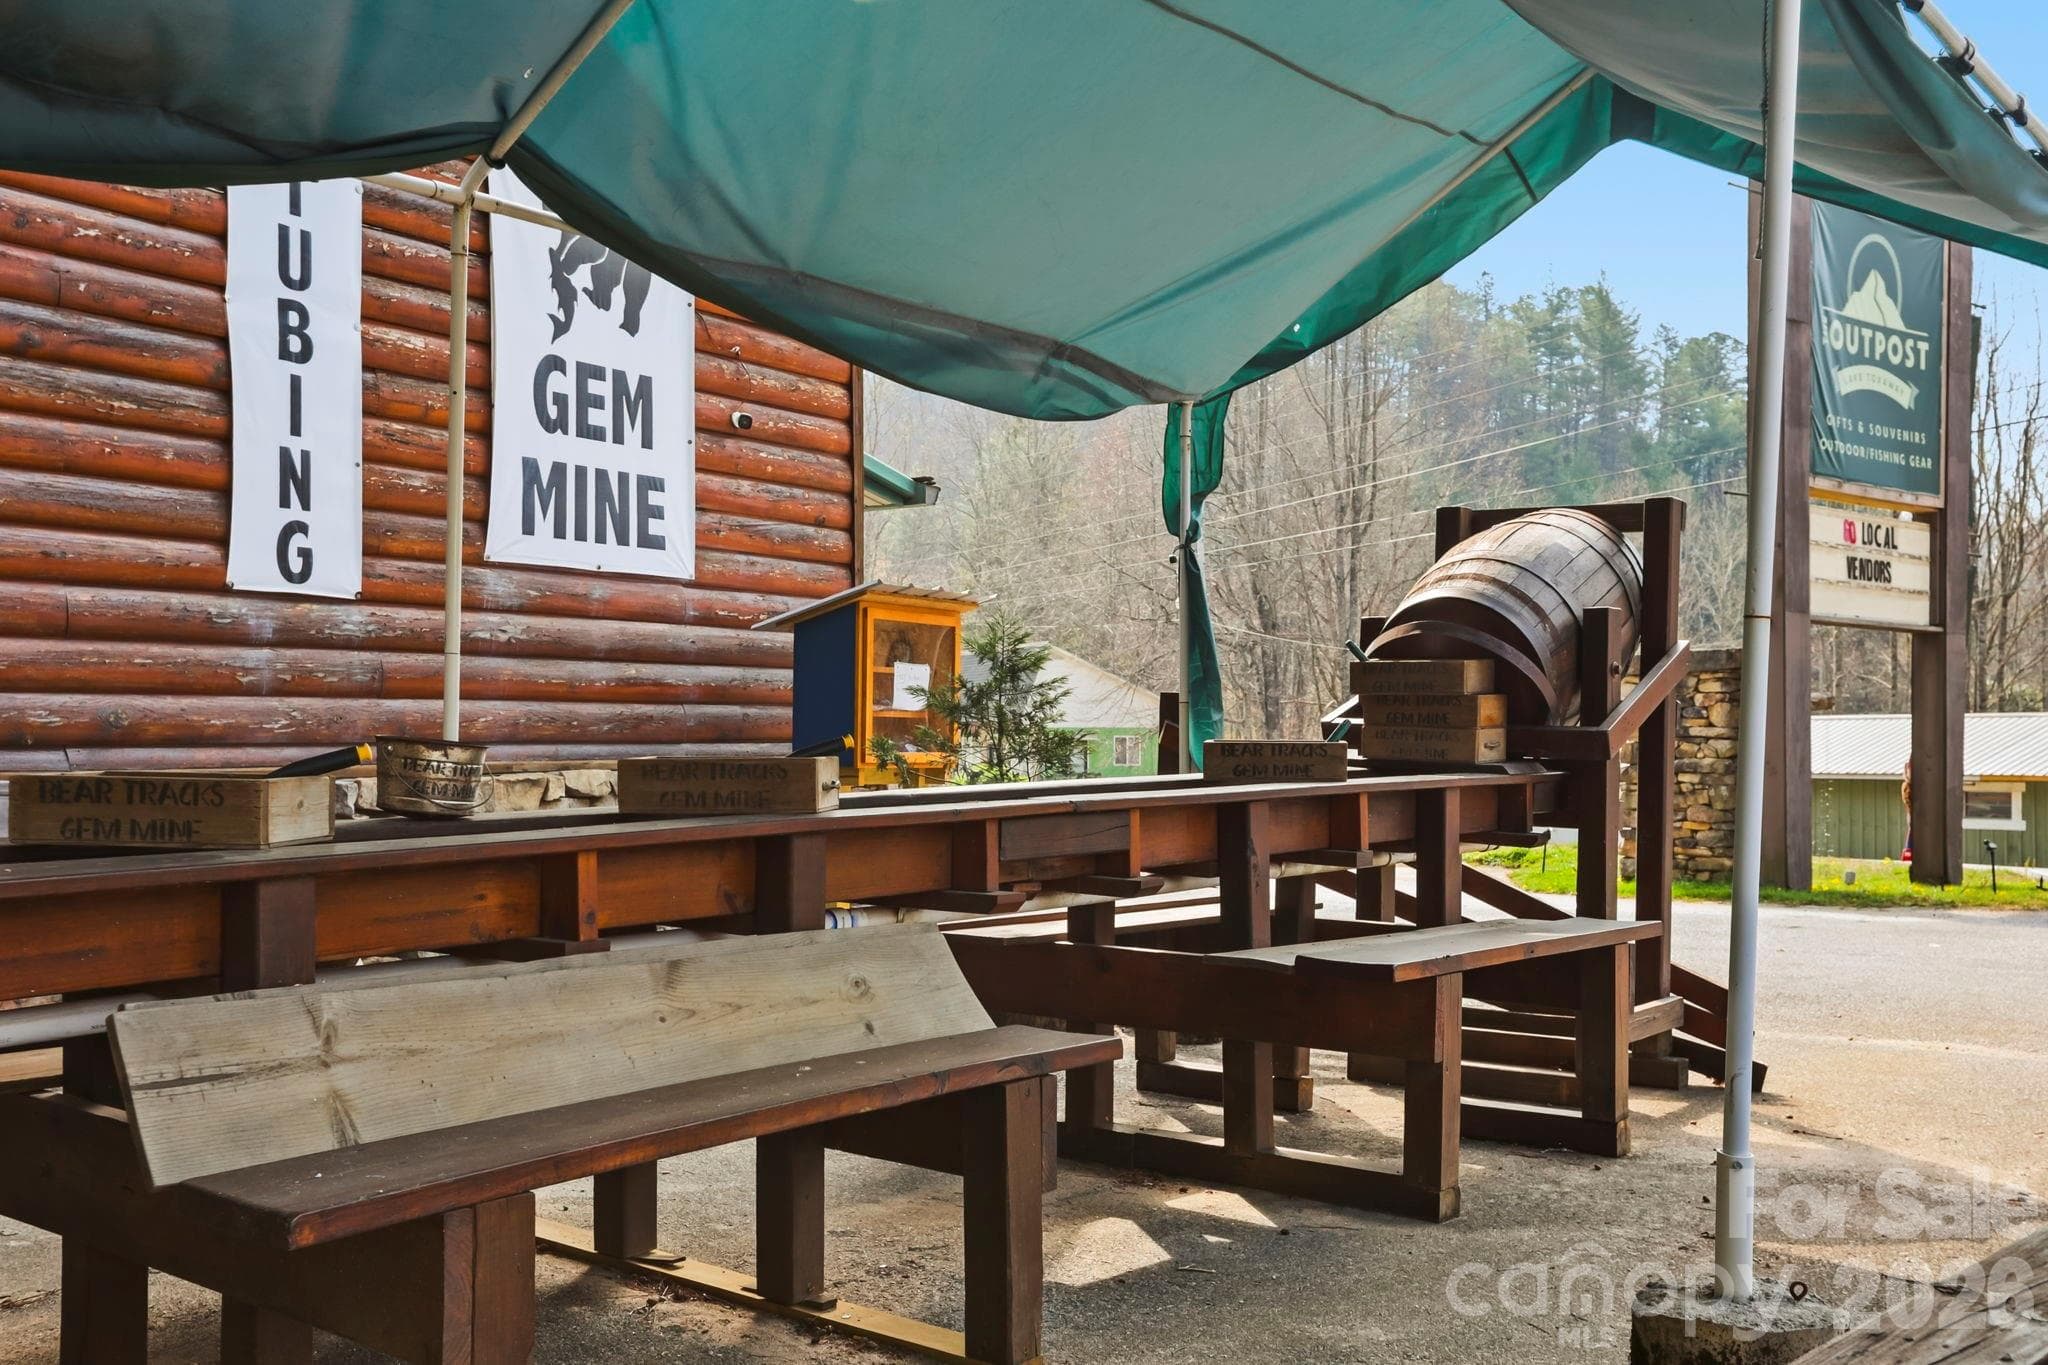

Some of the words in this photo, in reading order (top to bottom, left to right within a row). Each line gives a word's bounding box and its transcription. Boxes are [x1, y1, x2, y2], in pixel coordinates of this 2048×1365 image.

[1829, 319, 1930, 370] OUTPOST
[532, 353, 654, 451] GEM
[1868, 423, 1927, 445] SOUVENIRS
[1819, 438, 1906, 466] OUTDOOR/FISHING
[1908, 454, 1933, 469] GEAR
[520, 456, 667, 552] MINE
[1862, 521, 1898, 550] LOCAL
[1846, 555, 1892, 584] VENDORS
[38, 779, 113, 805] BEAR
[123, 780, 225, 808] TRACKS
